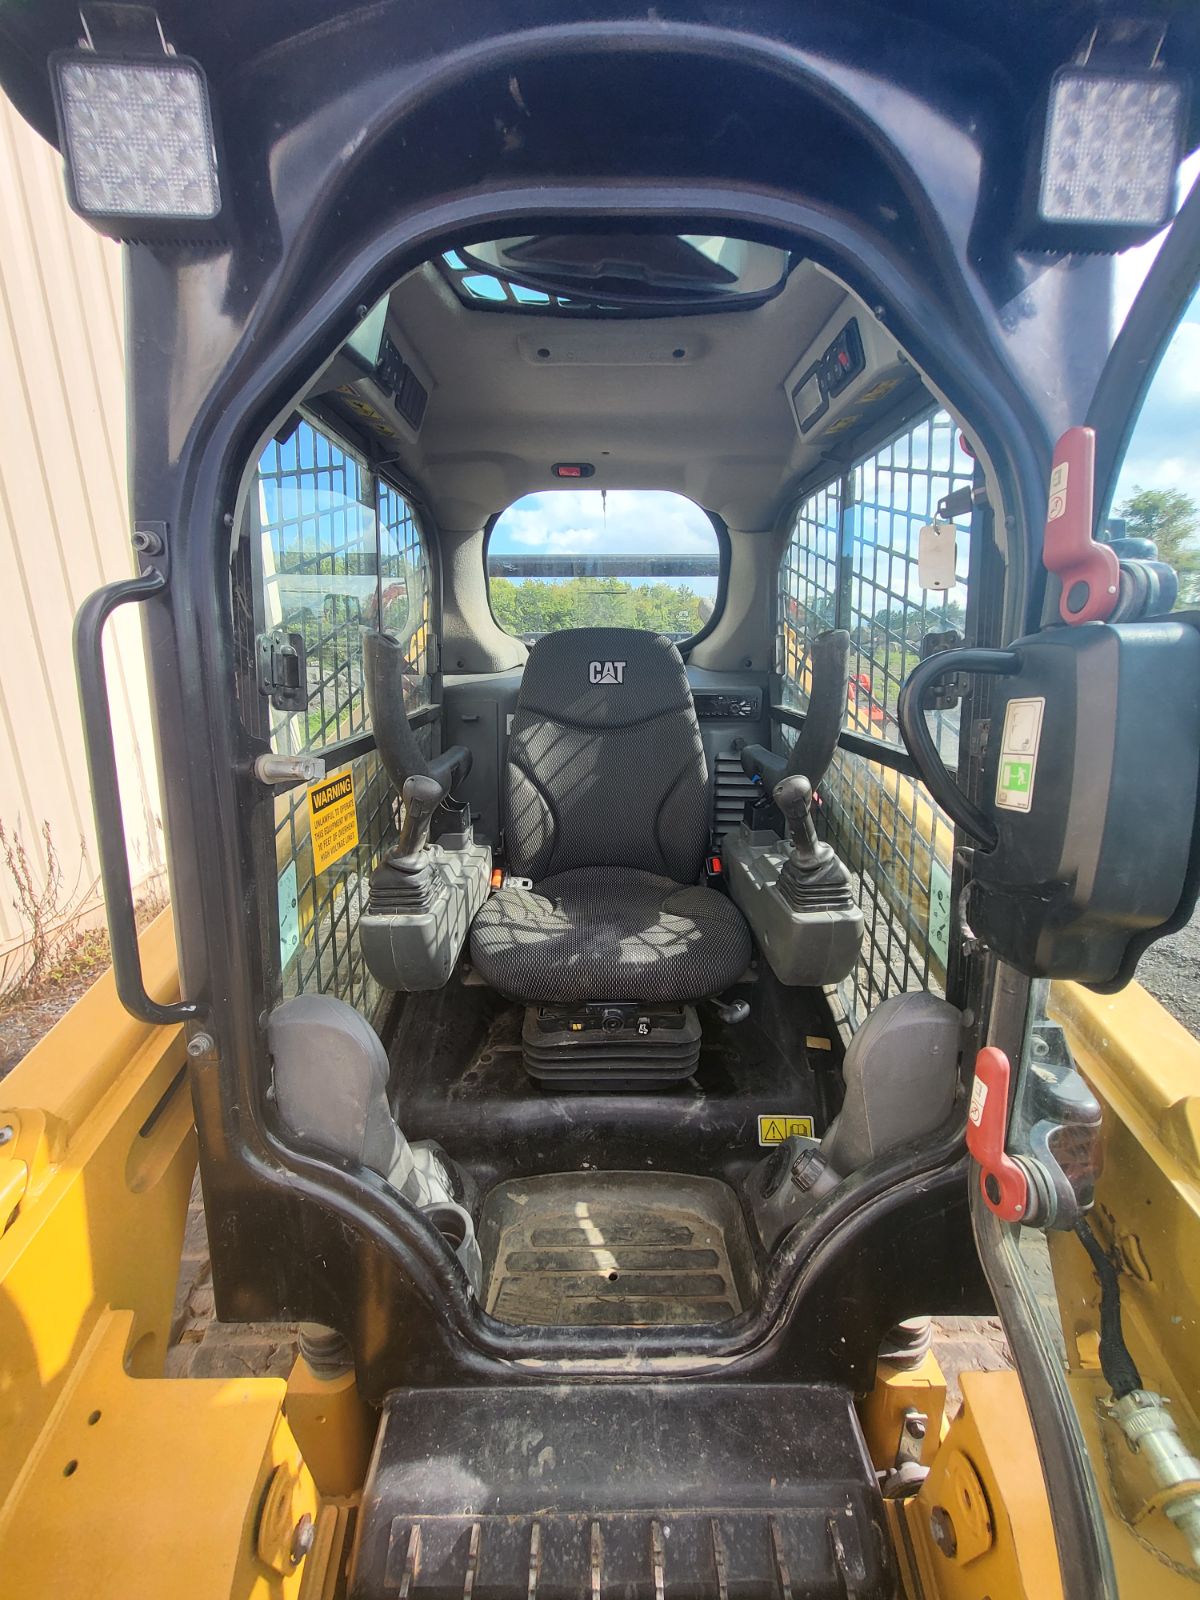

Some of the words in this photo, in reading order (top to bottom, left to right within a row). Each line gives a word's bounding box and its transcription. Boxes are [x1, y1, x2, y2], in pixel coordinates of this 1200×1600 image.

[589, 661, 627, 684] CAT
[313, 778, 351, 809] WARNING
[314, 812, 335, 829] UNLAWFUL
[314, 831, 324, 841] THIS
[324, 818, 343, 836] EQUIPMENT
[320, 850, 331, 861] HIGH
[331, 840, 345, 855] VOLTAGE
[323, 836, 332, 849] FEET
